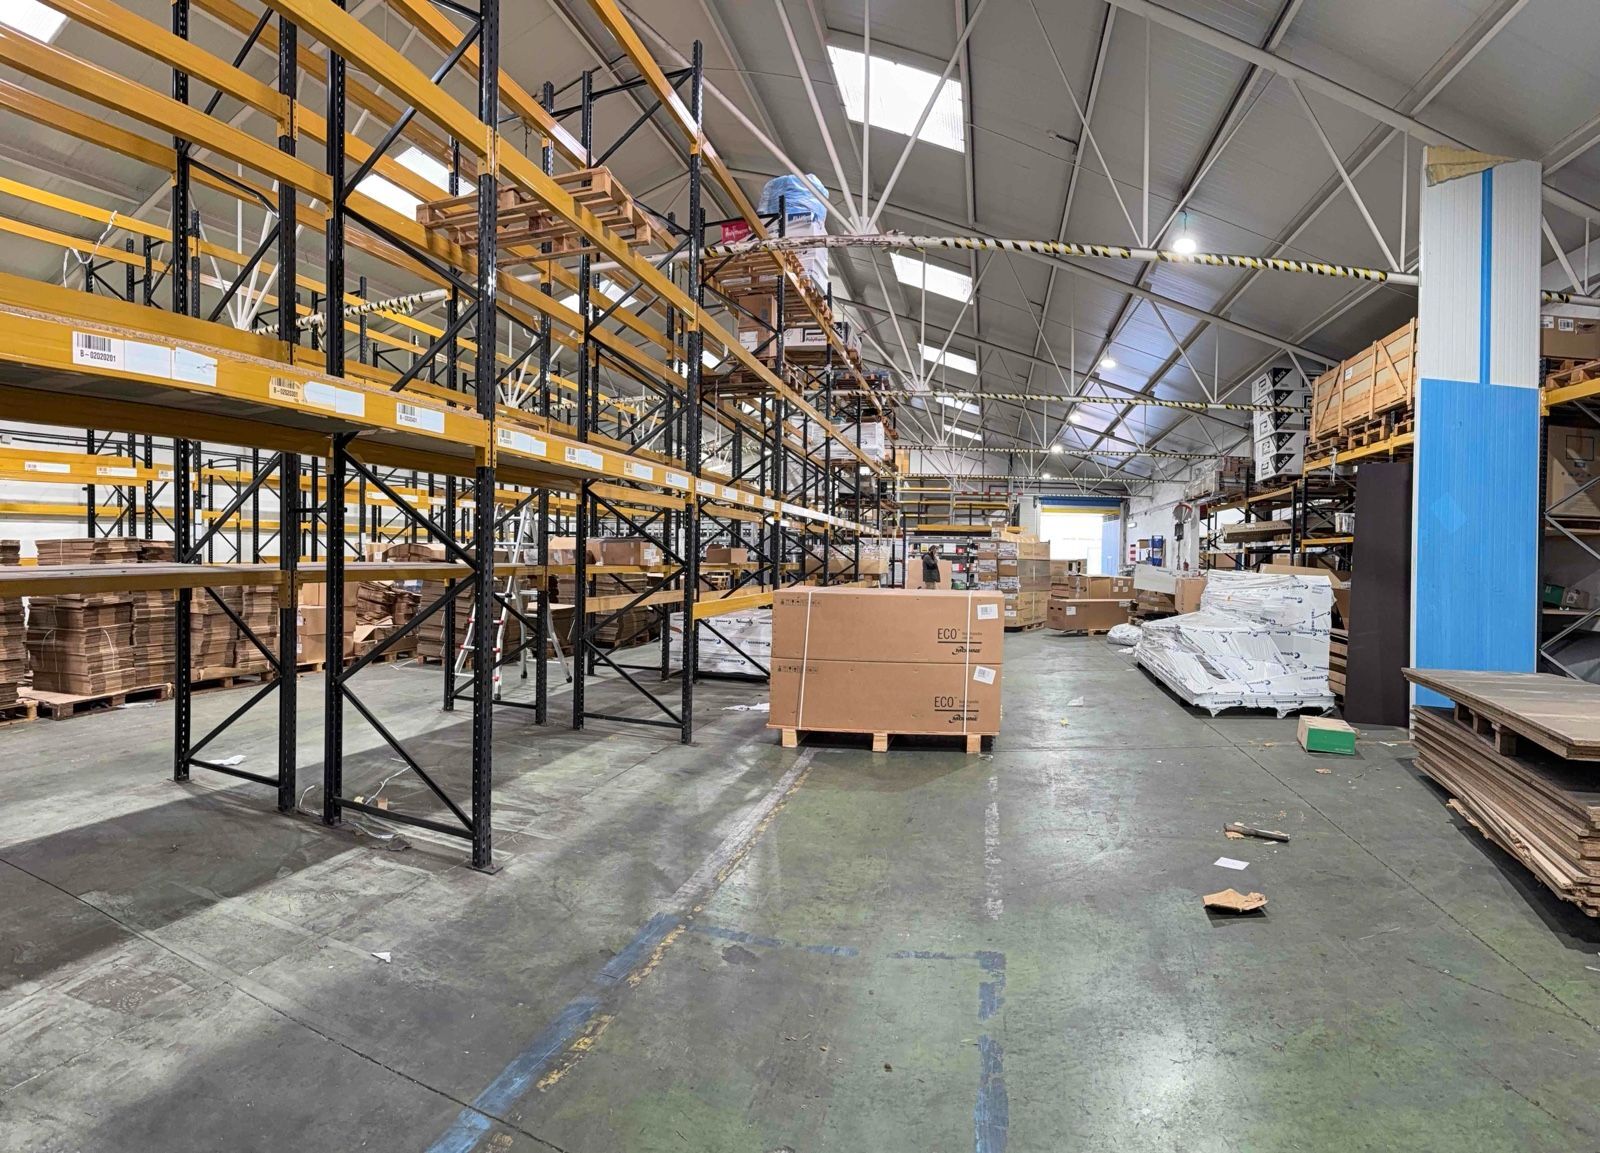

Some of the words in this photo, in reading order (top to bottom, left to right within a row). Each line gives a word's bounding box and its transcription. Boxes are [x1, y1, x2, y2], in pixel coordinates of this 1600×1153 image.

[1274, 370, 1287, 382] BLACK
[1276, 392, 1288, 405] BLACK
[1278, 434, 1291, 447] BLACK
[1277, 455, 1290, 468] BLACK
